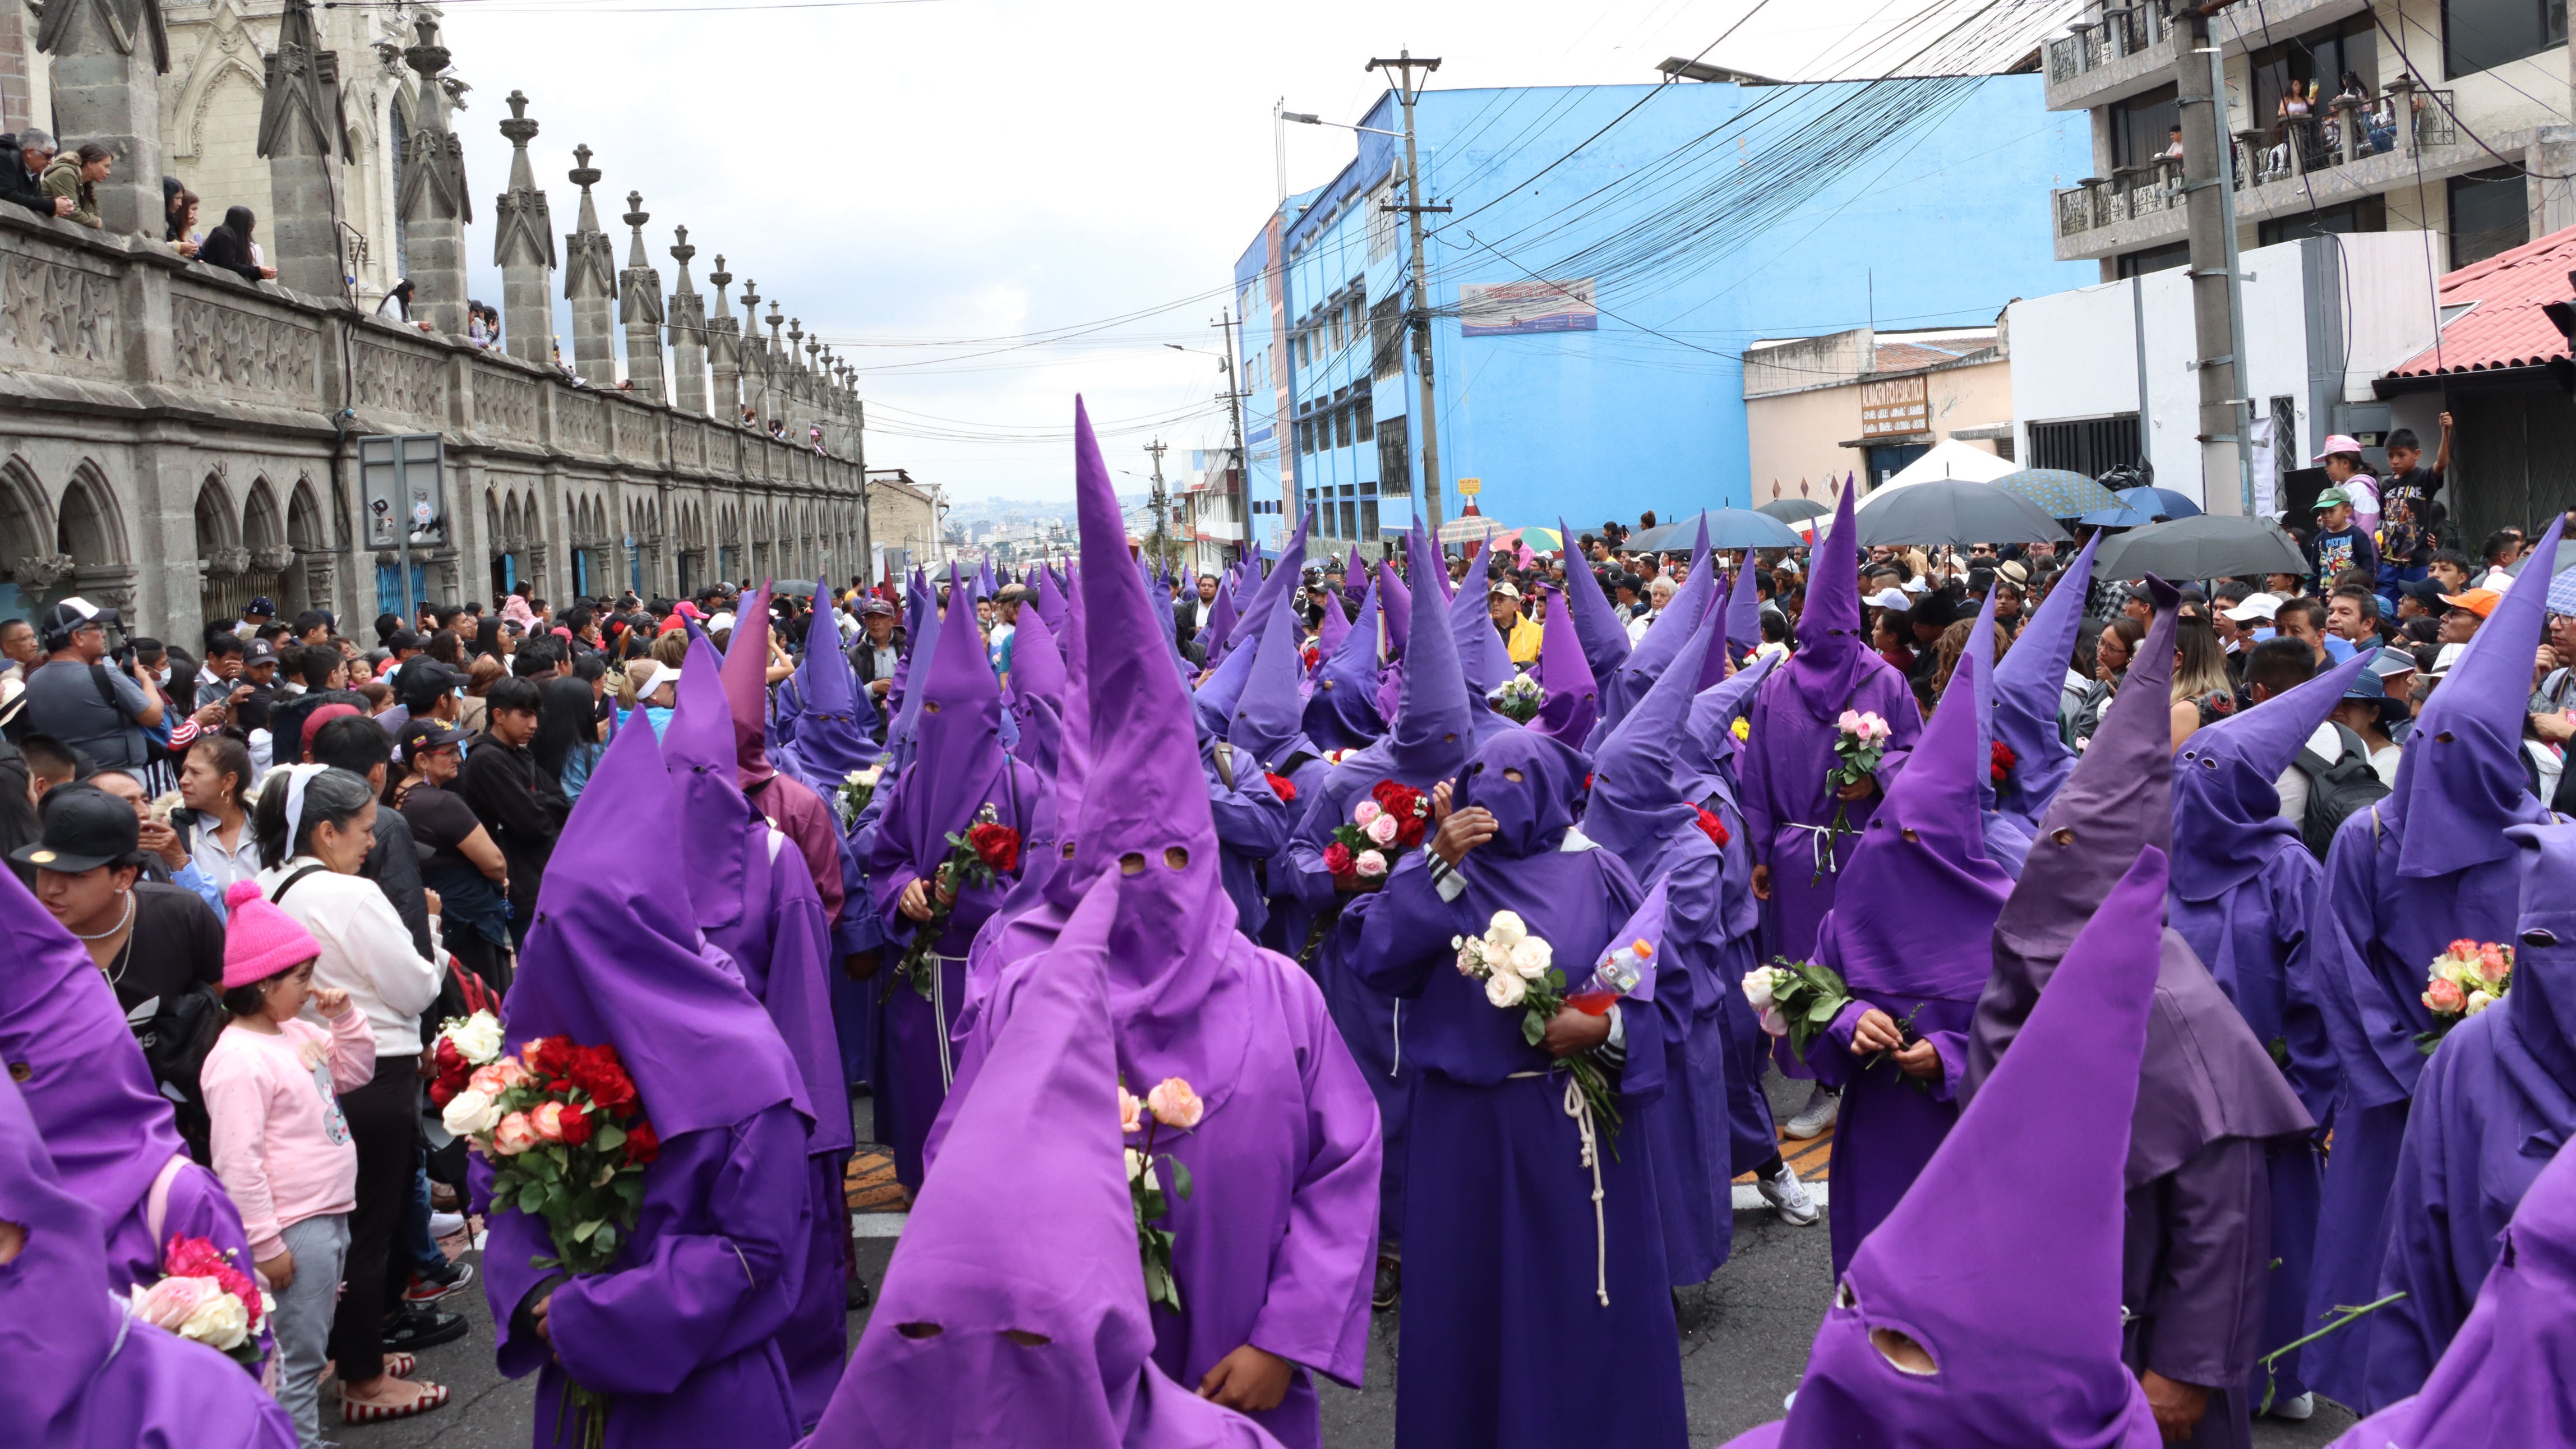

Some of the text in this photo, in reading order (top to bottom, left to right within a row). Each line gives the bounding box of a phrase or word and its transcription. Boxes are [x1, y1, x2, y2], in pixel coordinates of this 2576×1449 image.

[1863, 377, 1924, 407] ALMACEN ECLESIASTICO
[2397, 485, 2422, 499] FIRE
